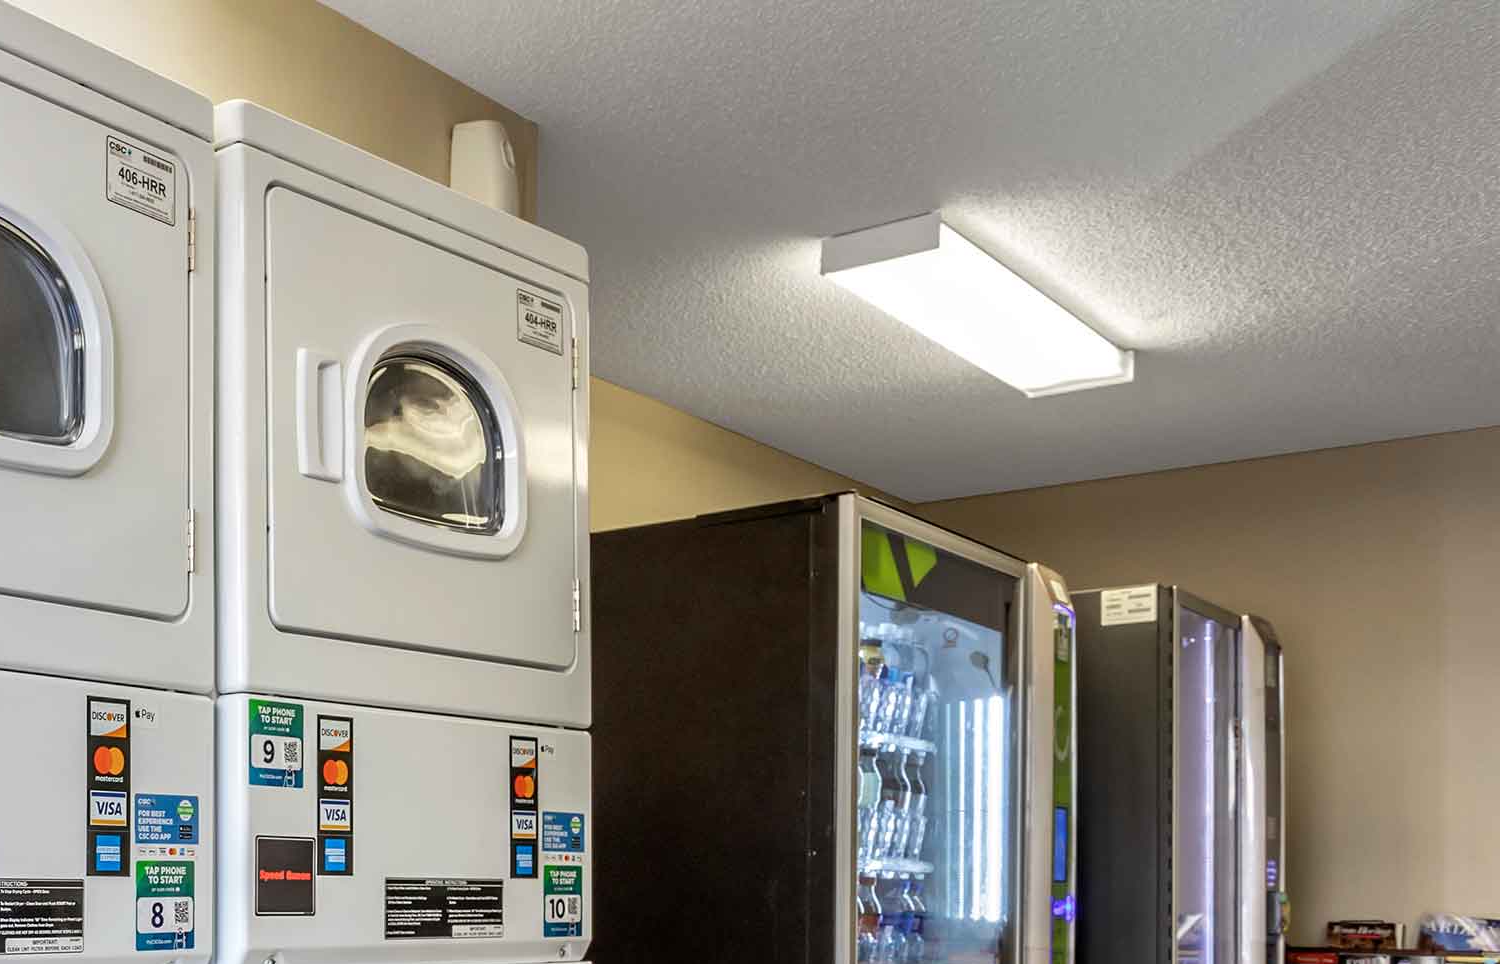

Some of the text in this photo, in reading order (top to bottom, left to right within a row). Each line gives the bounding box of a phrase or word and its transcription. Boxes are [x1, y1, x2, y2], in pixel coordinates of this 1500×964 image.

[109, 141, 127, 154] CSC
[118, 166, 166, 197] 406-HRR
[92, 711, 125, 722] DISCOVER
[141, 709, 155, 722] Pay
[258, 705, 296, 717] TAP PHONE
[261, 714, 293, 725] TO START
[321, 728, 349, 738] DISCOVER
[263, 740, 275, 764] 9
[96, 801, 122, 816] VISA
[325, 808, 346, 821] VISA
[516, 819, 533, 829] VISA
[160, 833, 171, 841] APP
[145, 866, 186, 875] TAP PHONE
[148, 875, 183, 884] TO START
[549, 898, 566, 919] 10
[151, 902, 164, 928] 8
